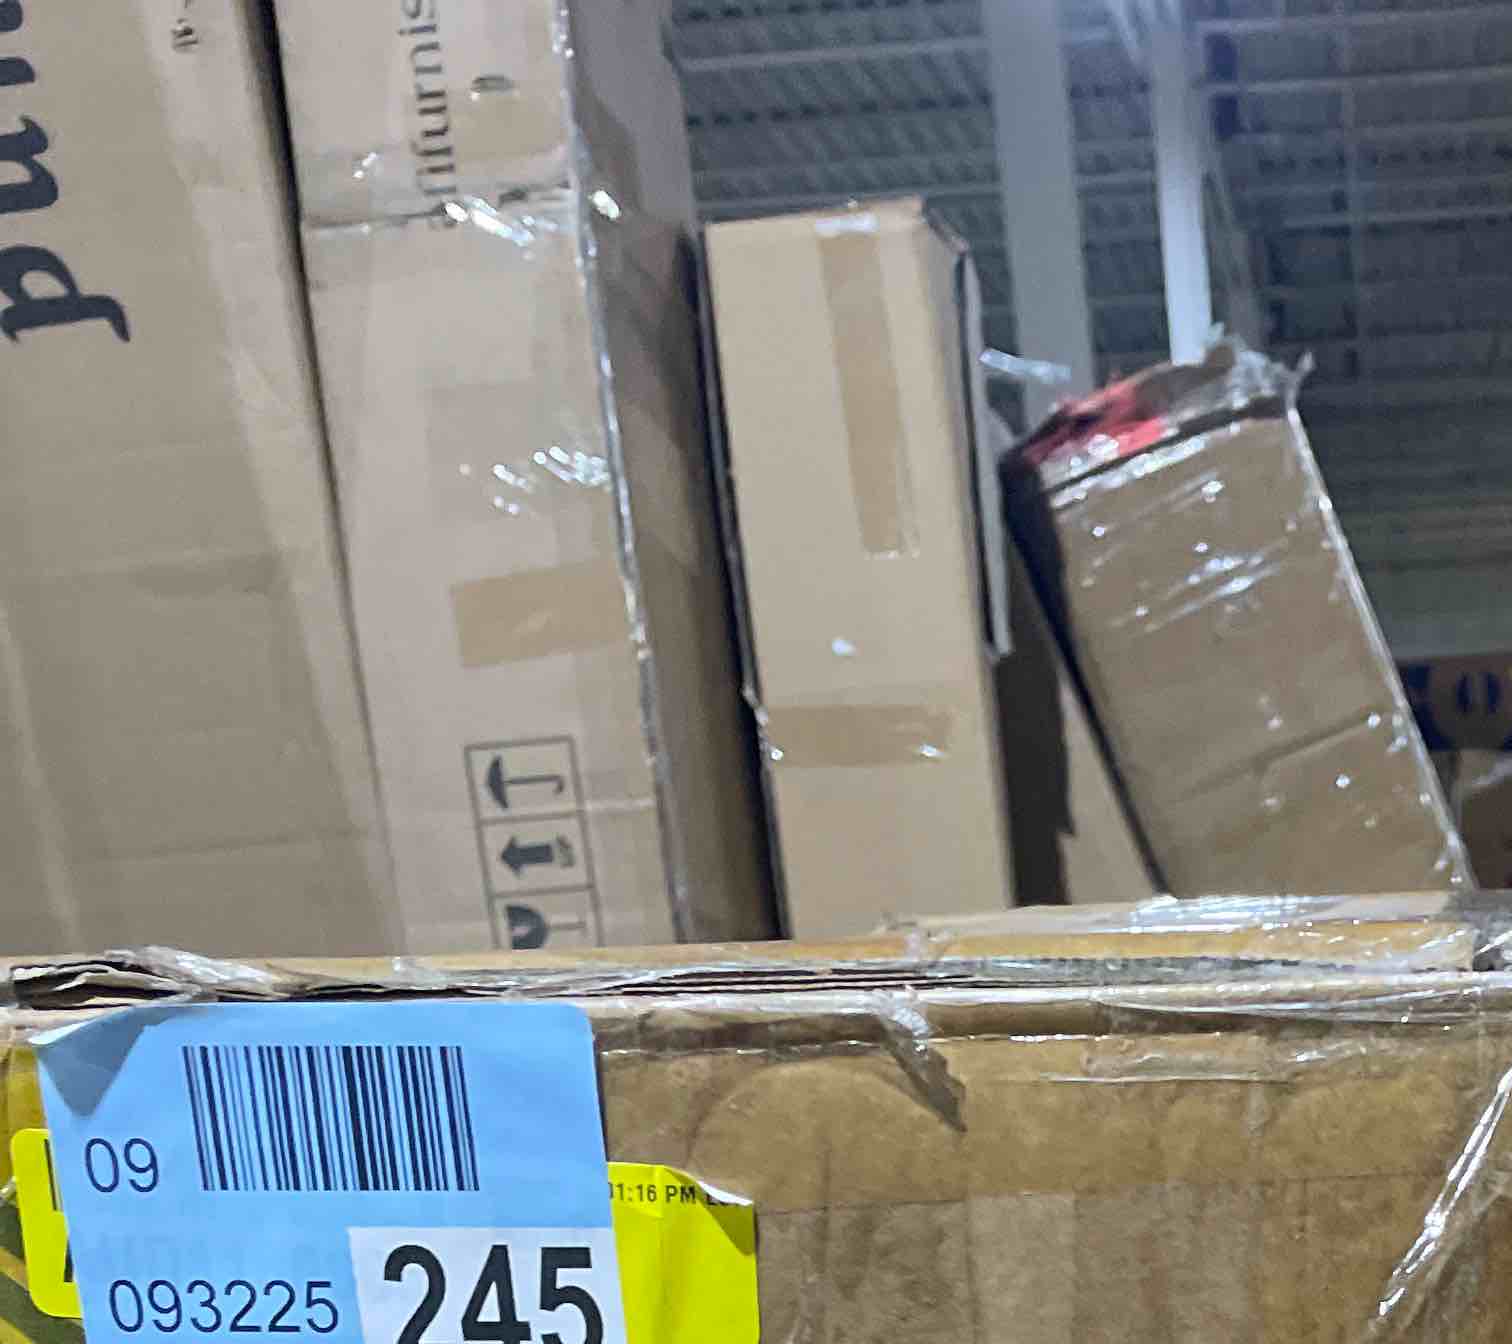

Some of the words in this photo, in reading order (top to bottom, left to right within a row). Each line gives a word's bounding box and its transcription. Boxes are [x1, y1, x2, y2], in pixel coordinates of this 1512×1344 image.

[84, 1138, 159, 1194] 09
[665, 1184, 696, 1204] PM
[108, 1280, 339, 1333] 093225
